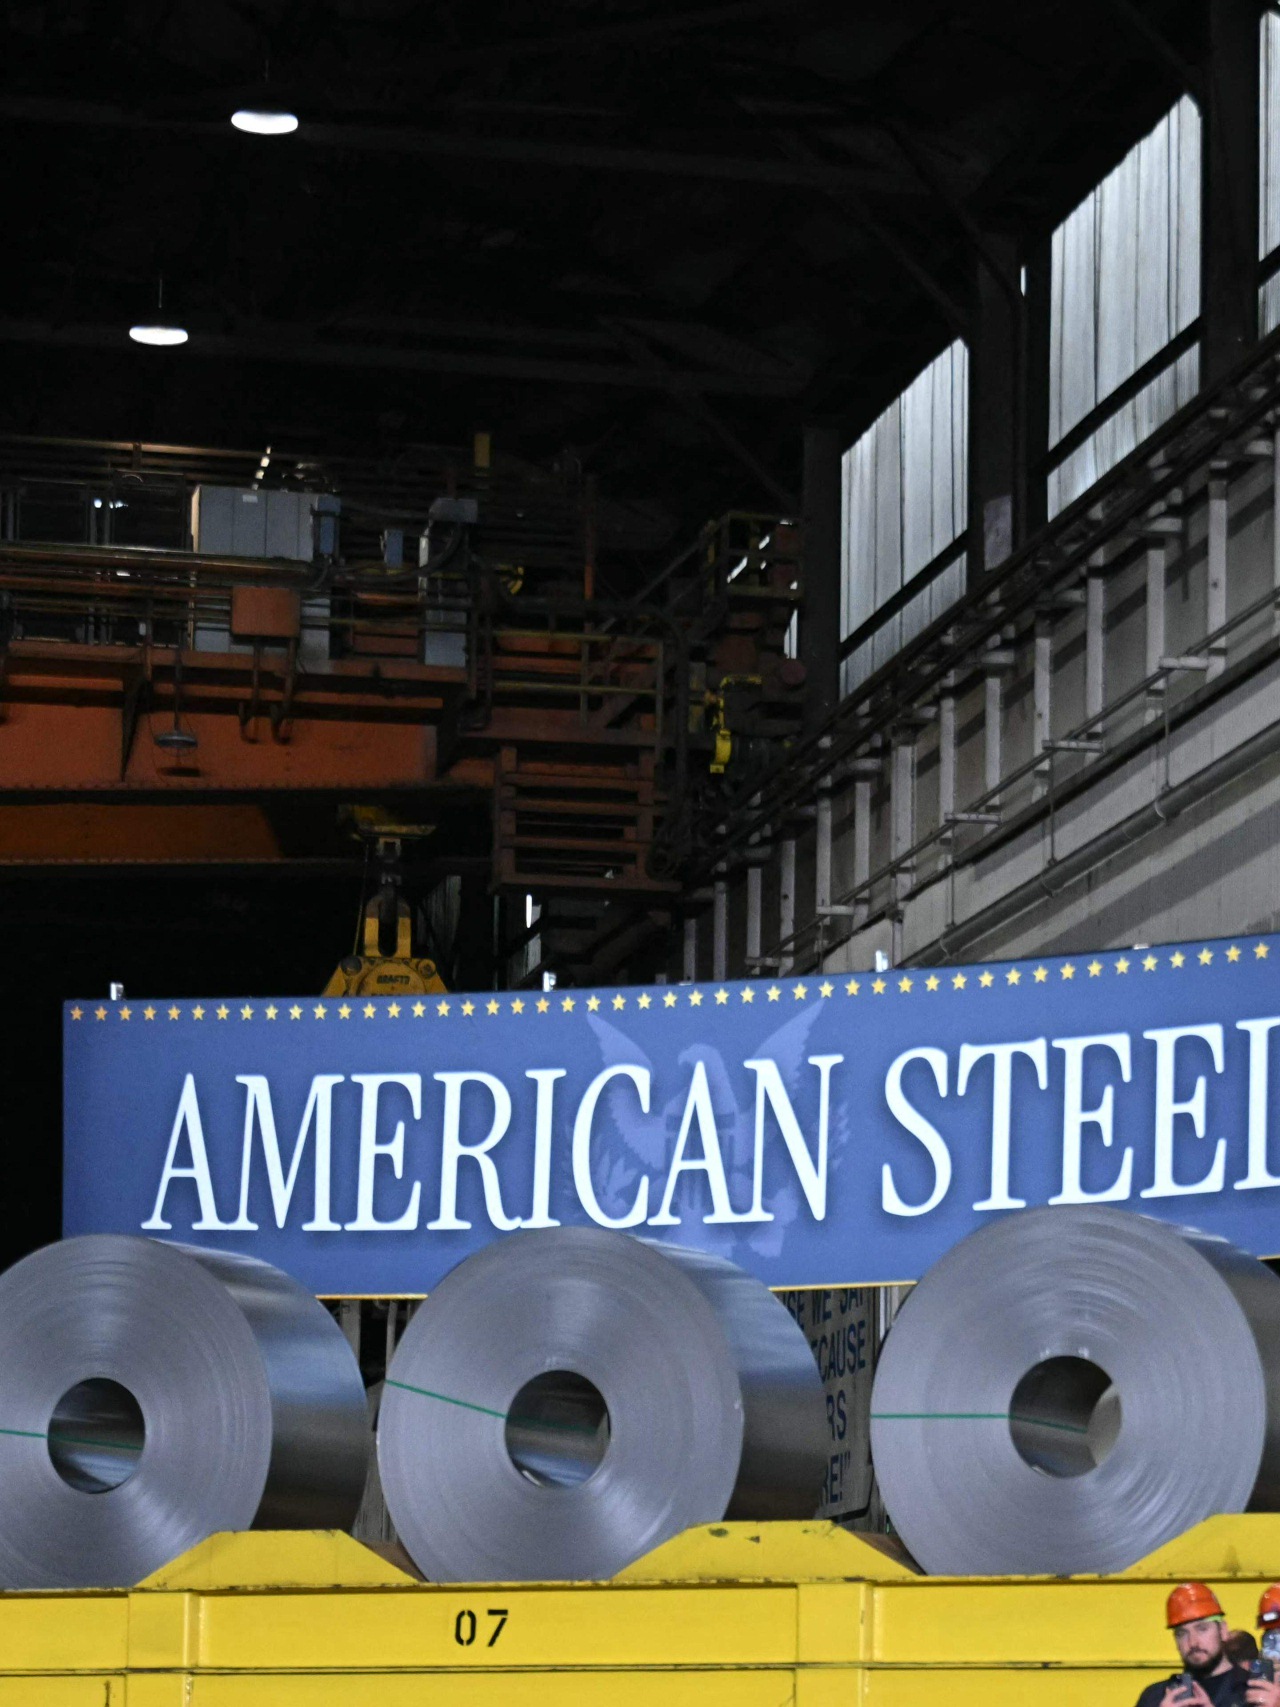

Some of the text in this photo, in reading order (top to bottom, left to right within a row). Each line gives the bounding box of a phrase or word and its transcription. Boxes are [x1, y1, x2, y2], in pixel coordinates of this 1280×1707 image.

[140, 1055, 845, 1232] AMERICAN
[811, 1320, 866, 1383] CAUSE
[825, 1389, 848, 1441] RS
[455, 1609, 509, 1648] 07
